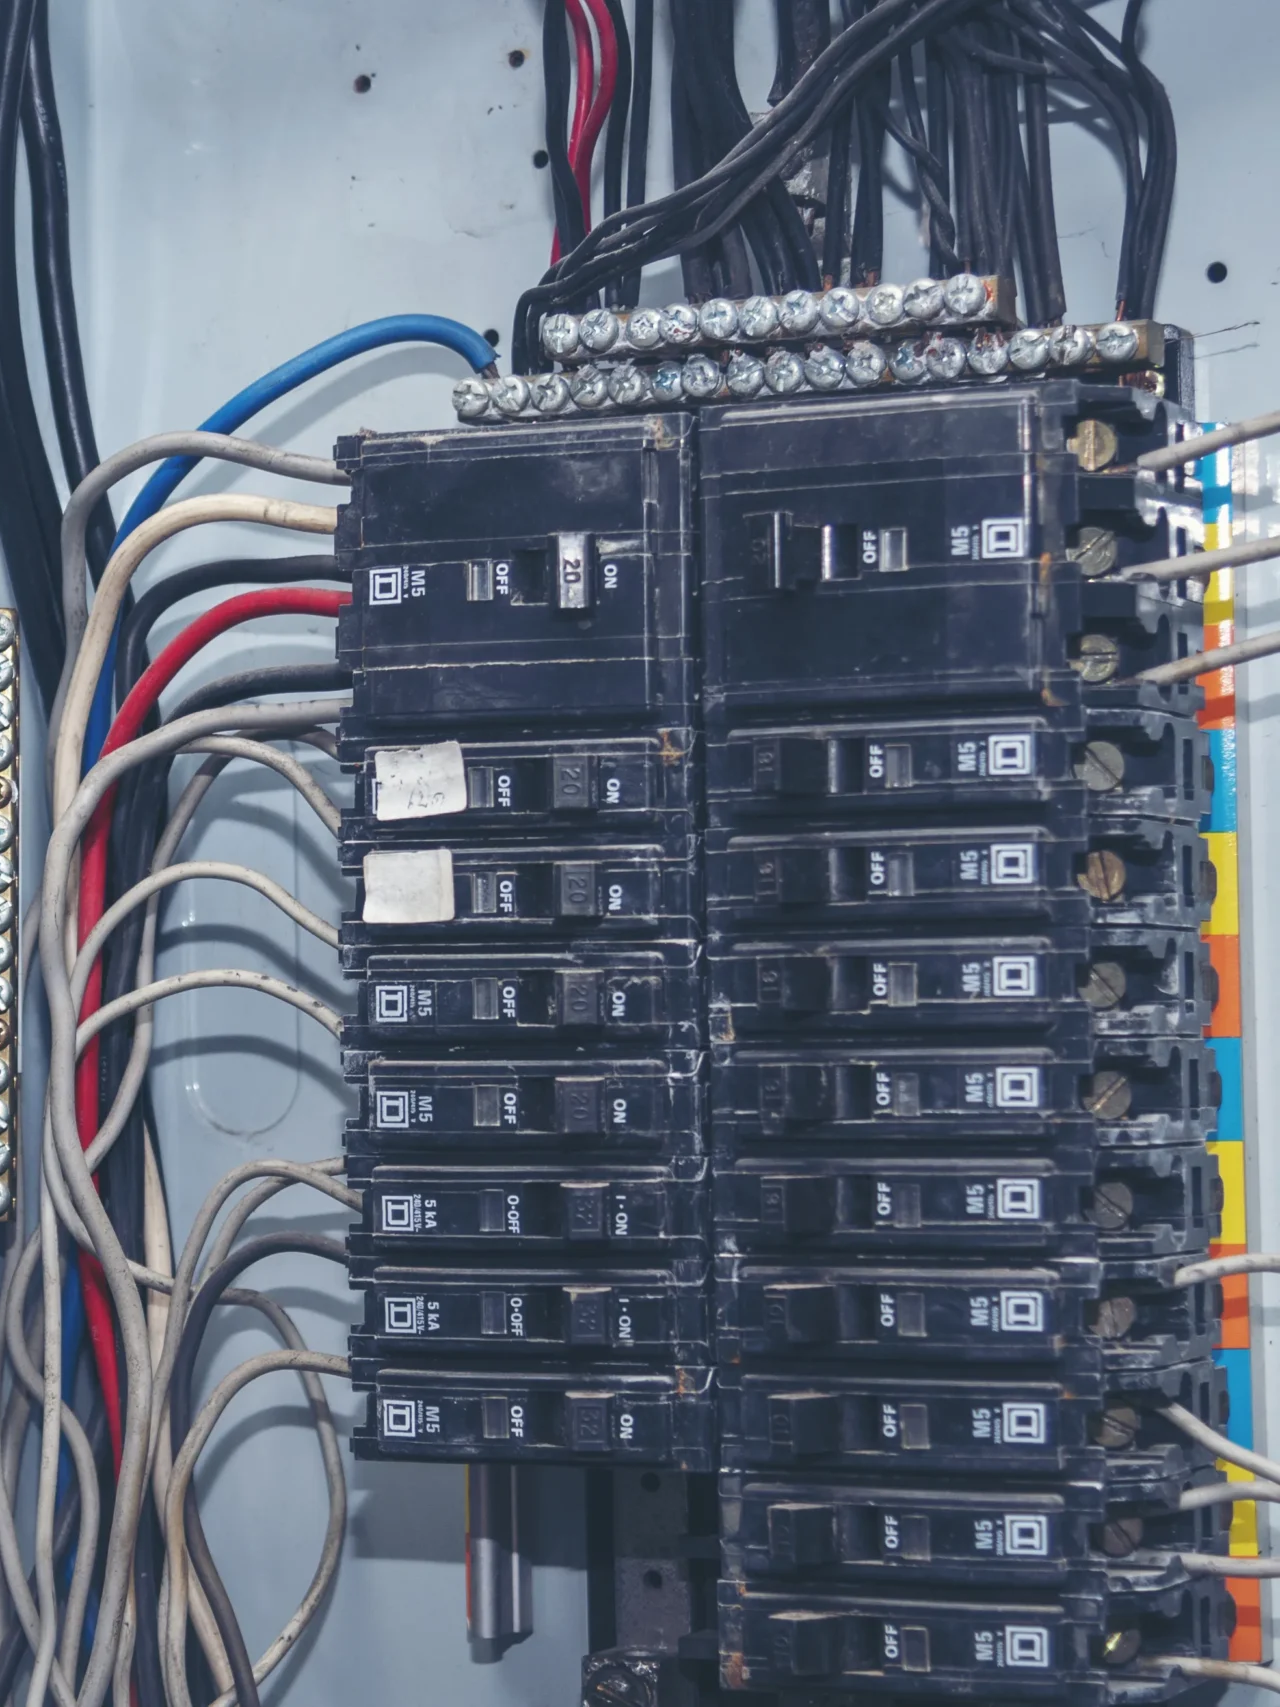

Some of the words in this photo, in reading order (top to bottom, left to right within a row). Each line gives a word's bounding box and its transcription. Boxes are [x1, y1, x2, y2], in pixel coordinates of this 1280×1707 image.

[863, 531, 877, 563] OFF
[951, 526, 969, 555] M5
[411, 570, 425, 596] M5
[496, 563, 509, 595] OFF
[564, 559, 581, 584] 20
[604, 564, 617, 588] ON
[869, 745, 883, 778] OFF
[958, 742, 976, 771] M5
[498, 775, 510, 806] OFF
[607, 779, 619, 803] ON
[871, 852, 884, 885] OFF
[960, 851, 978, 879] M5
[500, 881, 513, 912] OFF
[609, 885, 622, 910] ON
[873, 964, 887, 996] OFF
[963, 963, 980, 992] M5
[418, 990, 432, 1016] M5
[503, 986, 515, 1017] OFF
[612, 991, 625, 1016] ON
[876, 1073, 890, 1105] OFF
[965, 1073, 984, 1102] M5
[419, 1096, 432, 1122] M5
[504, 1093, 516, 1124] OFF
[613, 1099, 626, 1123] ON
[877, 1183, 891, 1215] OFF
[967, 1185, 984, 1213] M5
[881, 1295, 894, 1326] OFF
[970, 1297, 989, 1325] M5
[426, 1407, 440, 1432] M5
[511, 1406, 523, 1437] OFF
[620, 1414, 633, 1438] ON
[883, 1405, 896, 1437] OFF
[973, 1409, 990, 1437] M5
[885, 1516, 898, 1548] OFF
[975, 1521, 992, 1548] M5
[885, 1625, 898, 1658] OFF
[975, 1632, 993, 1660] M5
